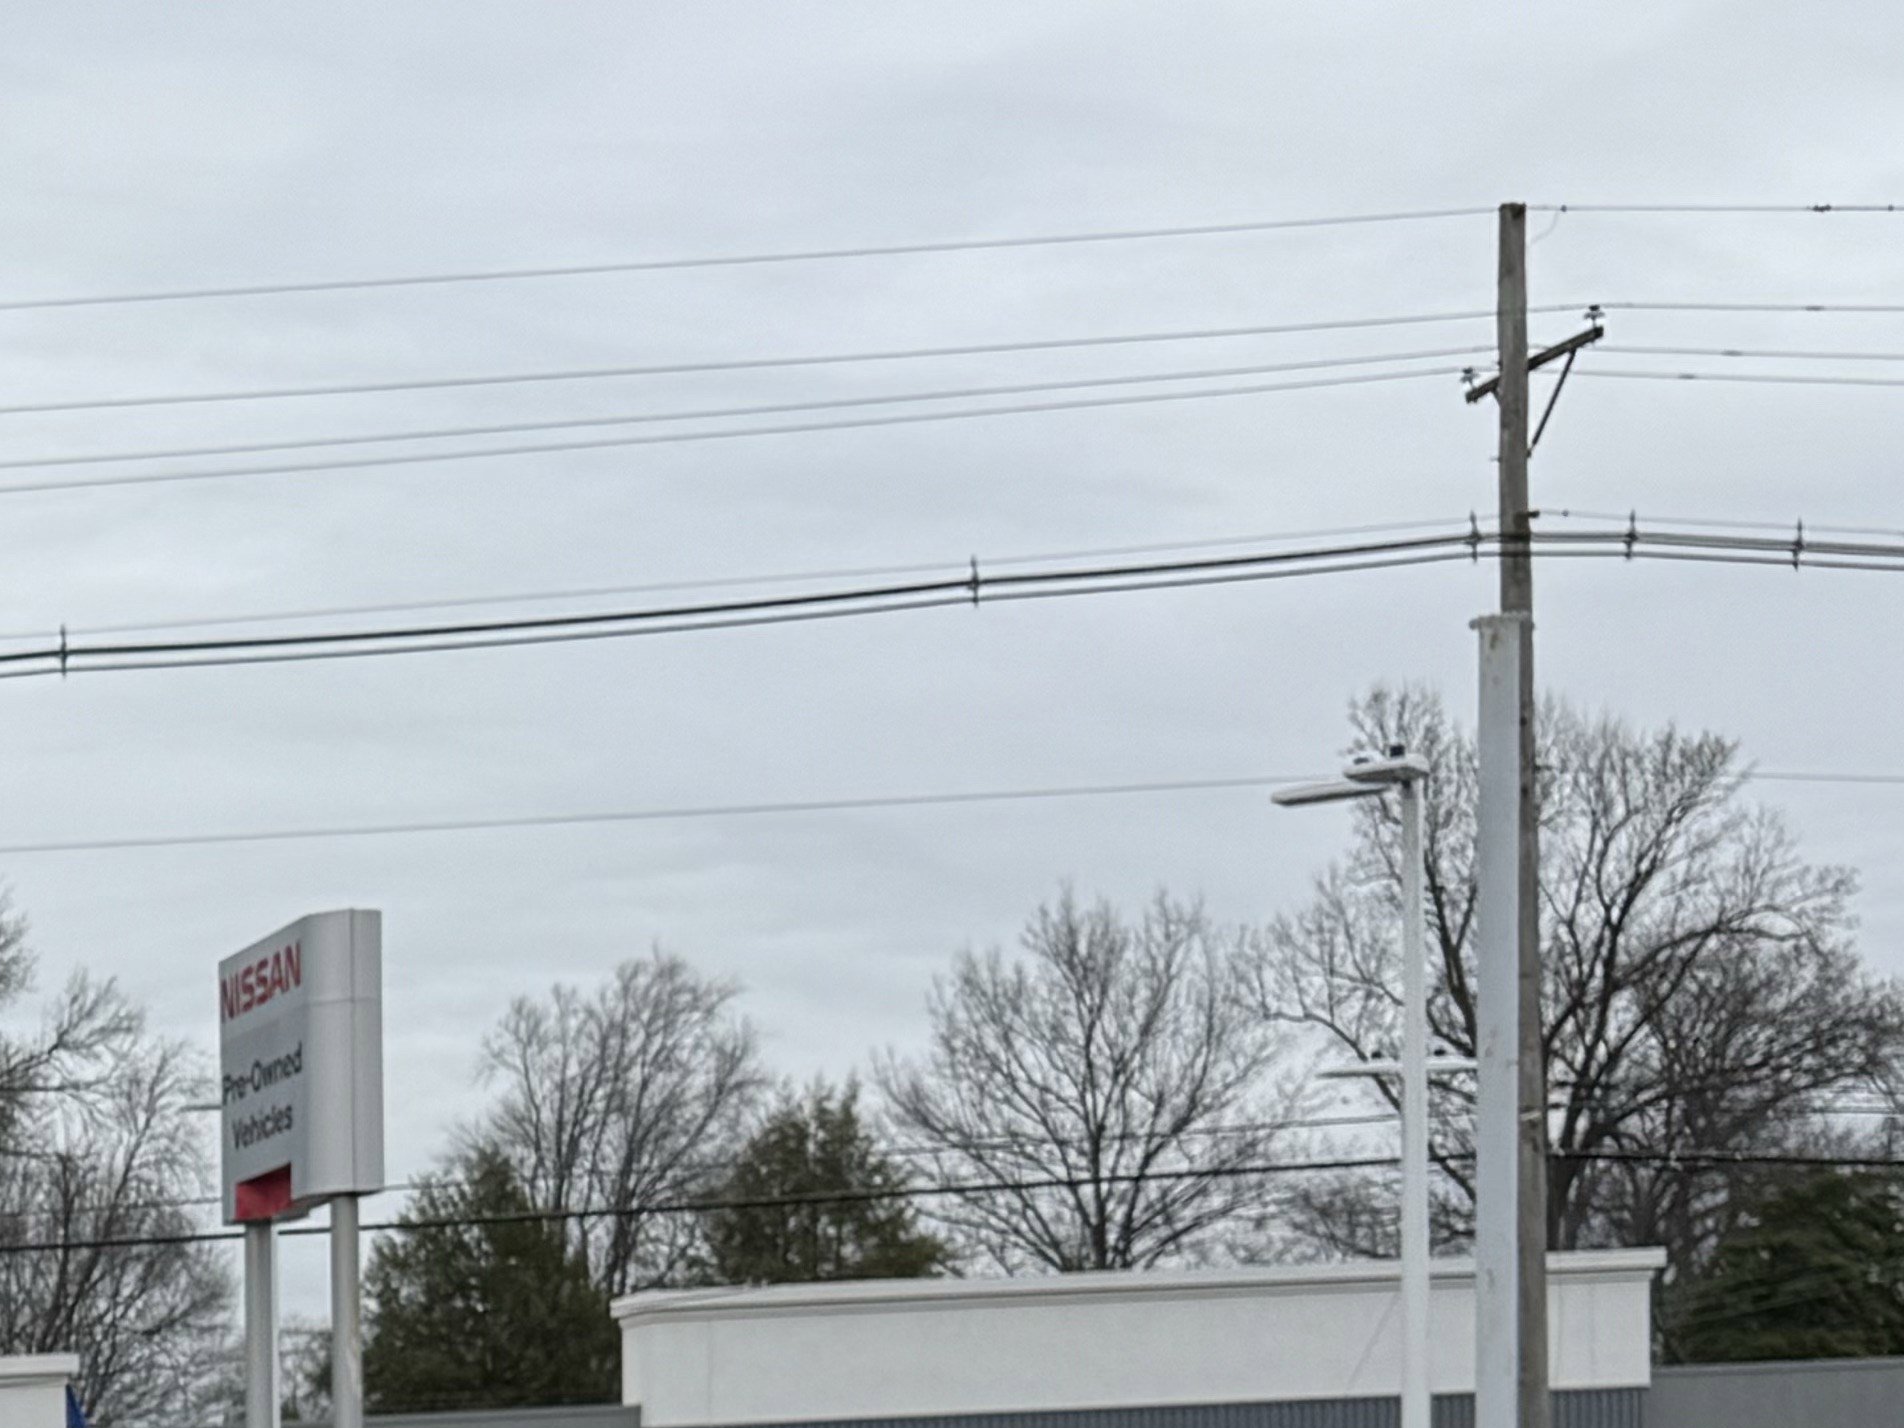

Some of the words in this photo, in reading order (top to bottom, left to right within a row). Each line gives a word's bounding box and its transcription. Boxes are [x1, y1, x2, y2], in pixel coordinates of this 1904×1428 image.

[220, 938, 302, 1024] NISSAN
[222, 1040, 303, 1107] Pre-Owned
[231, 1104, 293, 1150] Vehicles
